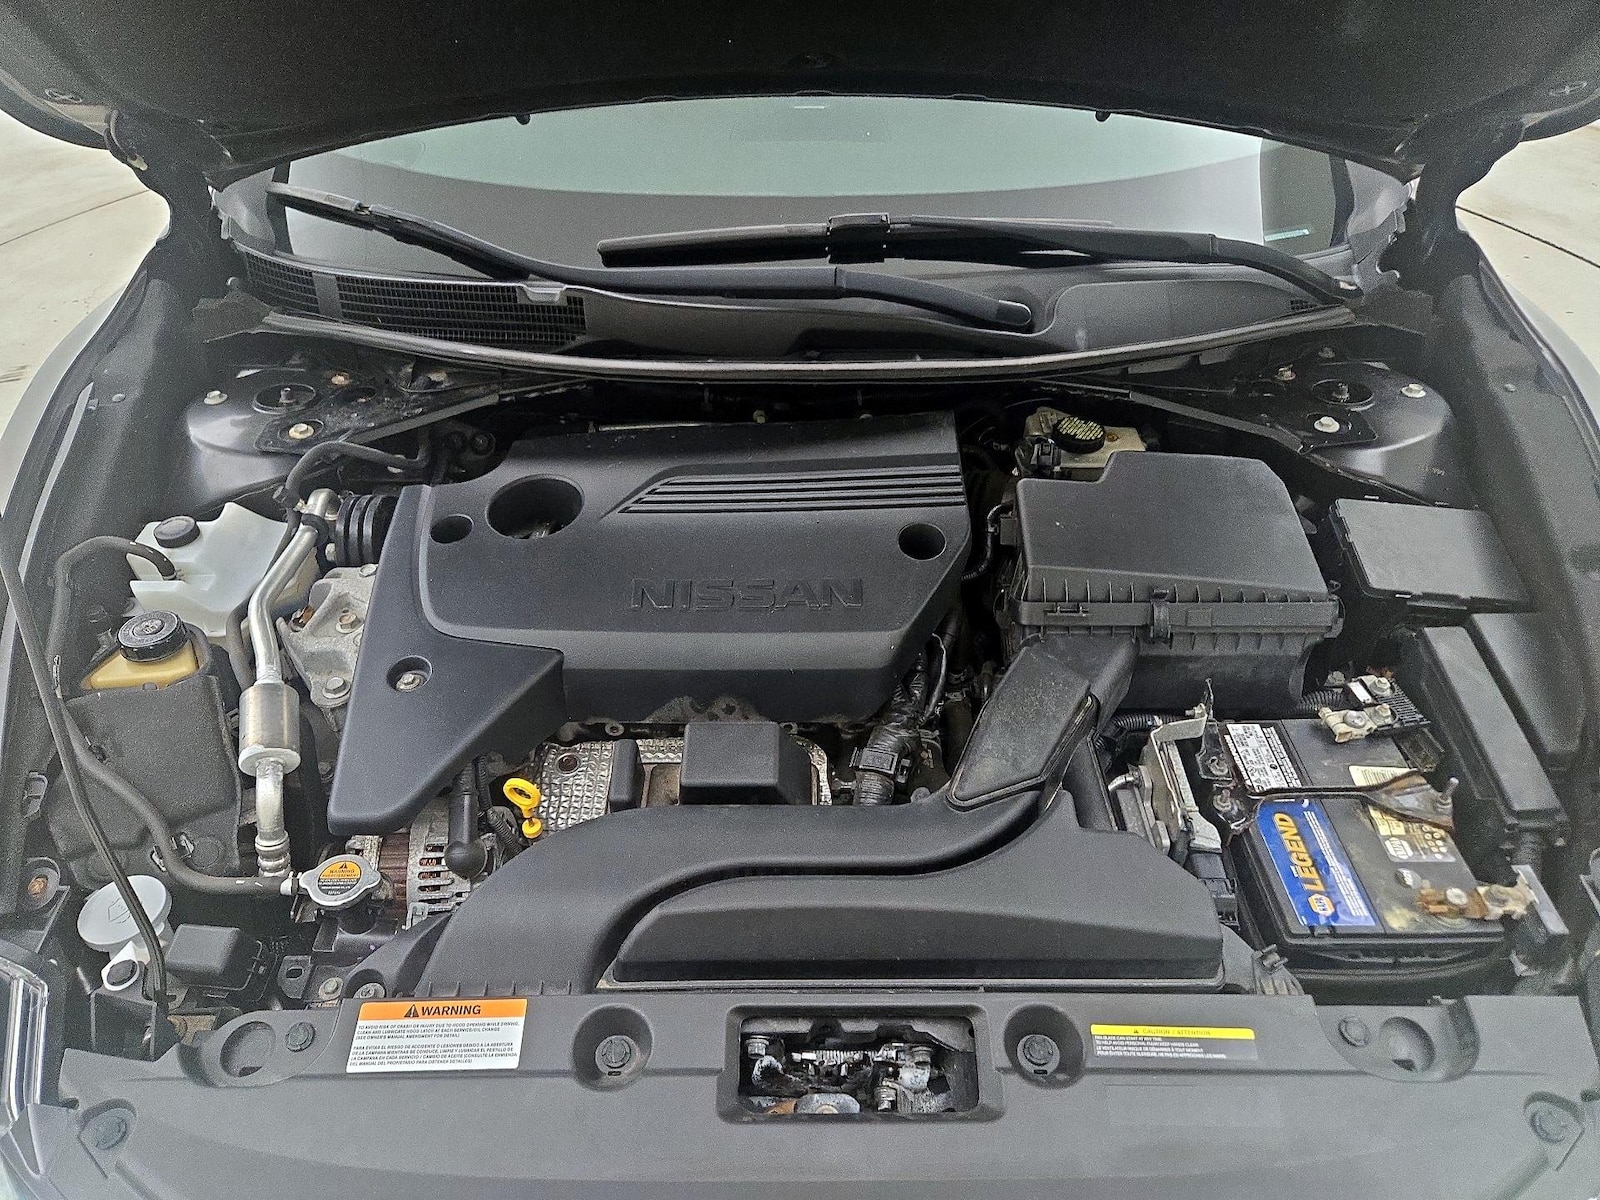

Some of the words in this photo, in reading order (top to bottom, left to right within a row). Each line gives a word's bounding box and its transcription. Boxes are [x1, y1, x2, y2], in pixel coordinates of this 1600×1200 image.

[631, 577, 864, 609] NISSAN
[1272, 811, 1326, 891] LEGEND
[422, 1005, 482, 1016] WARNING
